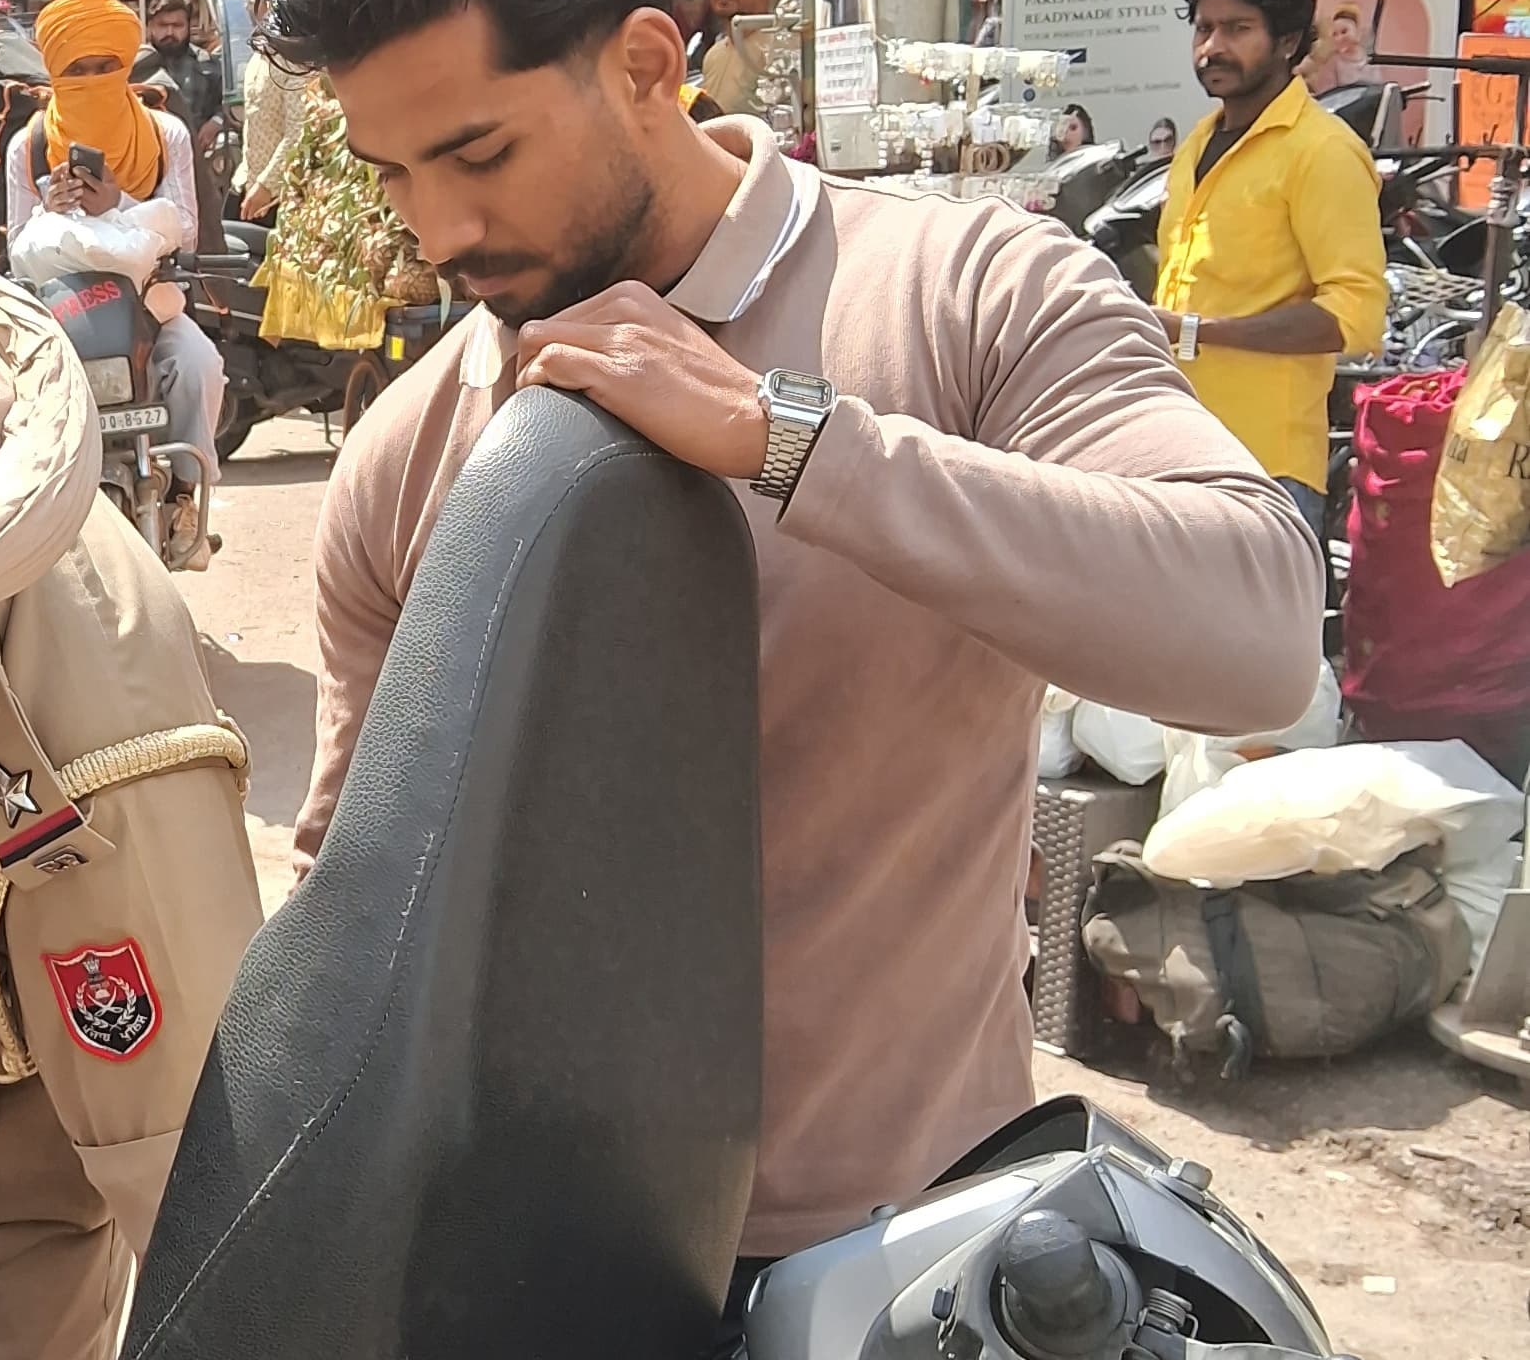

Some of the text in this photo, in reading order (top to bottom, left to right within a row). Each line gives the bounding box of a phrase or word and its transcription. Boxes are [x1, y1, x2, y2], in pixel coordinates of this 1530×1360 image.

[1024, 4, 1168, 26] READYMADE STYLES
[50, 280, 122, 324] PRESS
[124, 409, 162, 427] 8527
